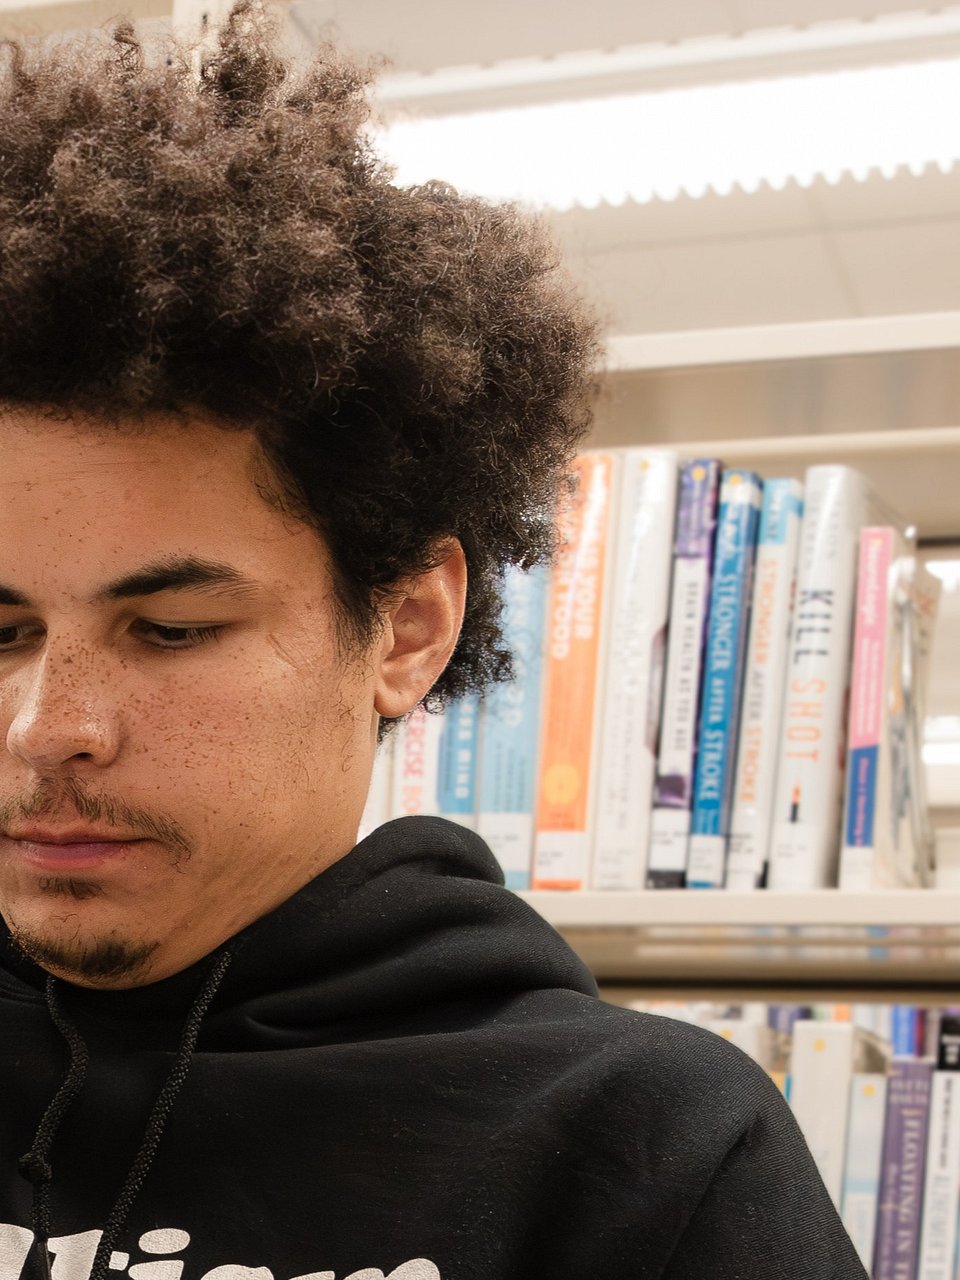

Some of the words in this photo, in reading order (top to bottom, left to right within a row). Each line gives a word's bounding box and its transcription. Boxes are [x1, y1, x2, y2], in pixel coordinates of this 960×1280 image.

[551, 589, 573, 660] FOOD
[711, 573, 739, 671] STRONGER
[754, 559, 780, 667] STRONGER
[794, 589, 835, 665] KILL
[748, 668, 767, 721] AFTER
[784, 677, 828, 763] SHOT
[701, 728, 725, 802] STROKE
[740, 726, 762, 805] STROKE
[899, 1119, 921, 1223] FLOATING
[896, 1229, 913, 1252] IN
